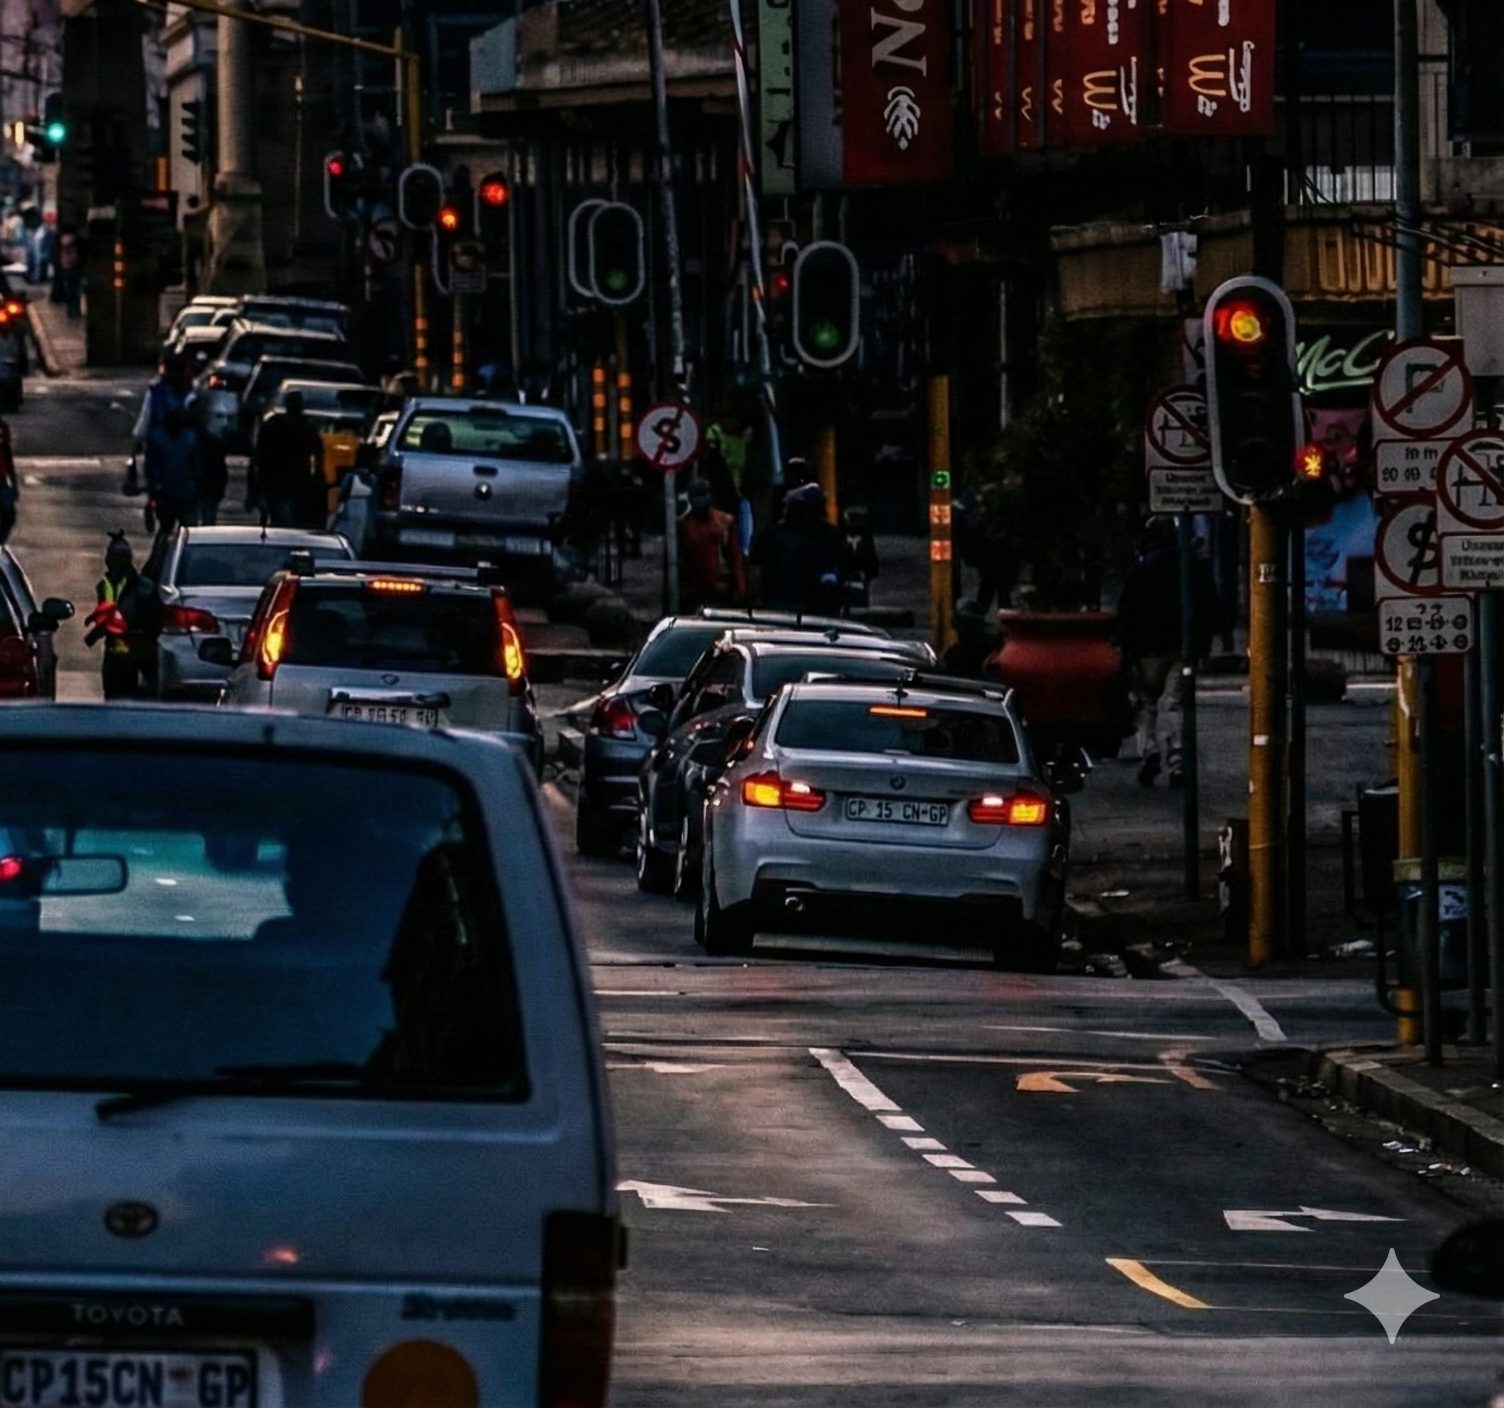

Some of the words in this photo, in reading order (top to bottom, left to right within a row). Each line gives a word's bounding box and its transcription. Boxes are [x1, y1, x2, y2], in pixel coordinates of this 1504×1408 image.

[870, 0, 927, 78] N
[848, 800, 866, 816] CP
[876, 802, 893, 818] 15
[902, 804, 947, 822] CN-GP
[70, 1303, 186, 1328] TOYOTA
[197, 1361, 250, 1408] GP
